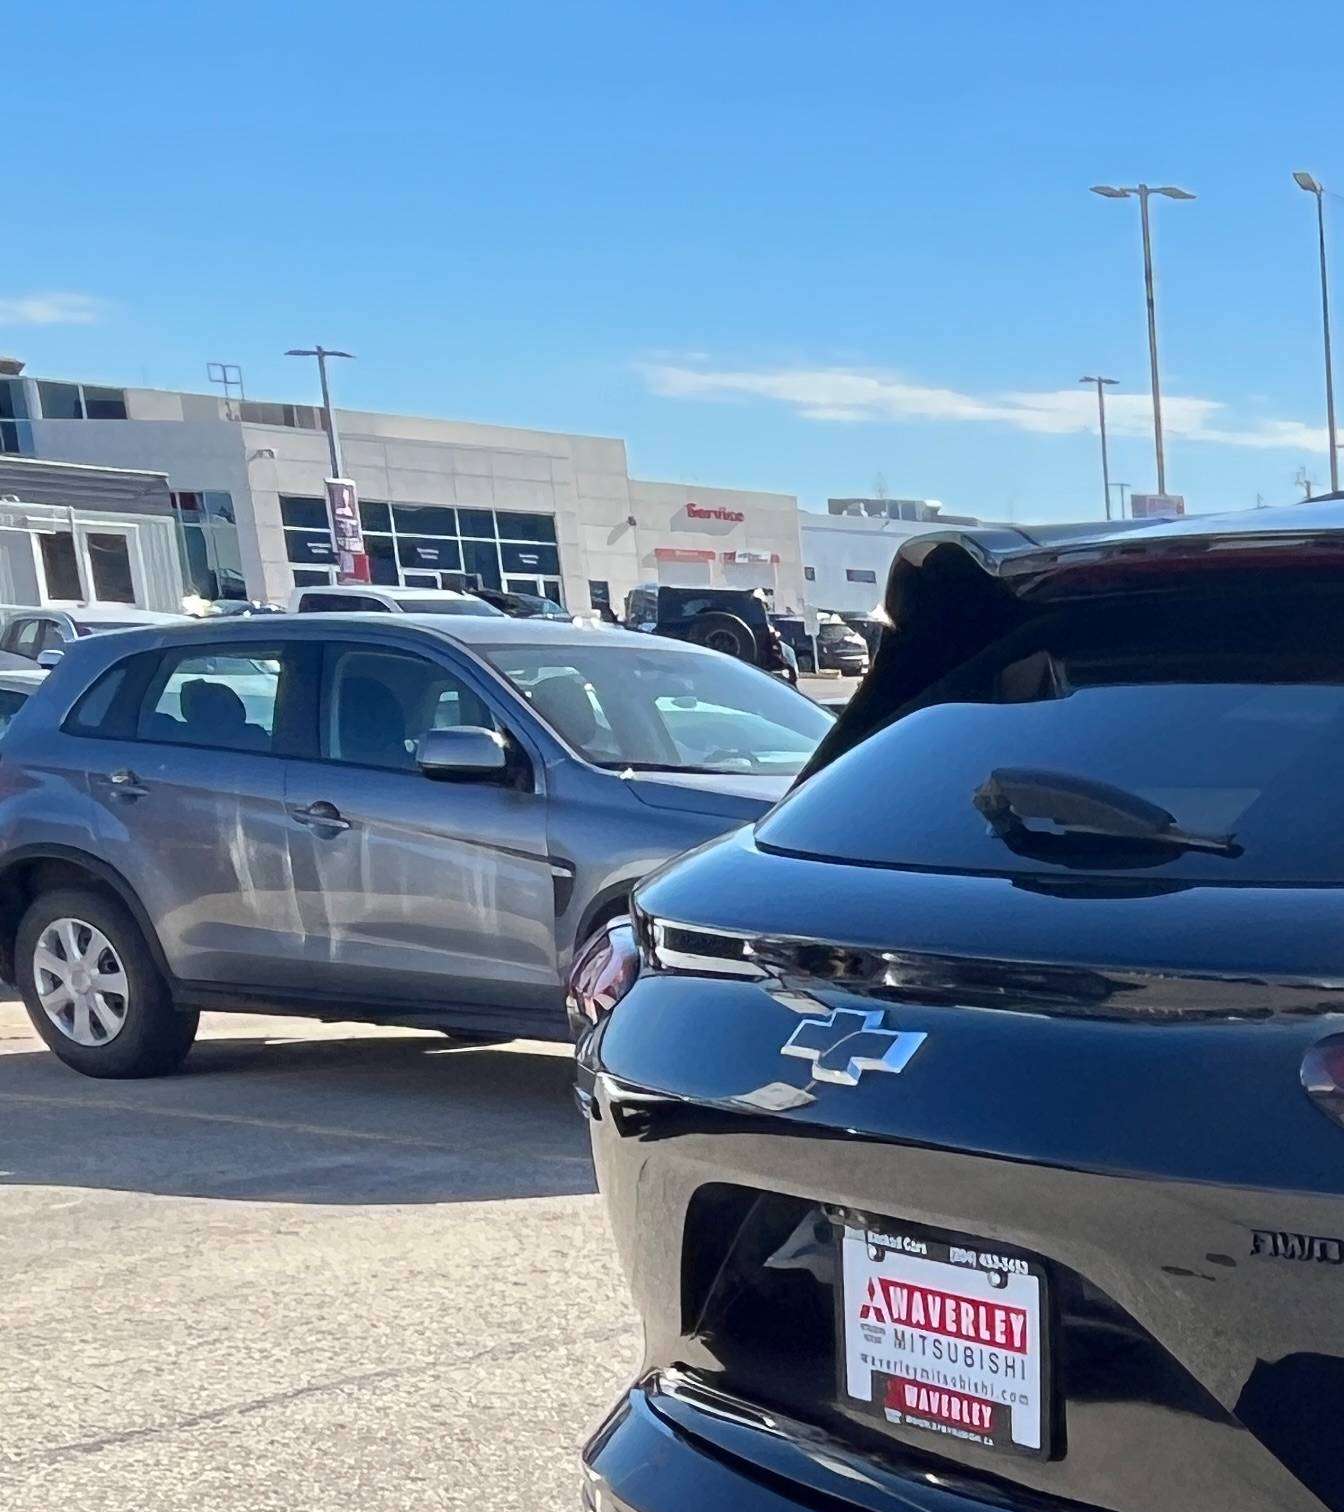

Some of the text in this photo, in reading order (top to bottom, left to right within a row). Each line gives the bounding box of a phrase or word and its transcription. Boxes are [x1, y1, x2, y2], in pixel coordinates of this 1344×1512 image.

[686, 503, 744, 522] Service
[888, 1285, 1024, 1348] WAVERLEY
[894, 1327, 1026, 1380] MITSUBISHI
[904, 1383, 992, 1428] WAVERLEY
